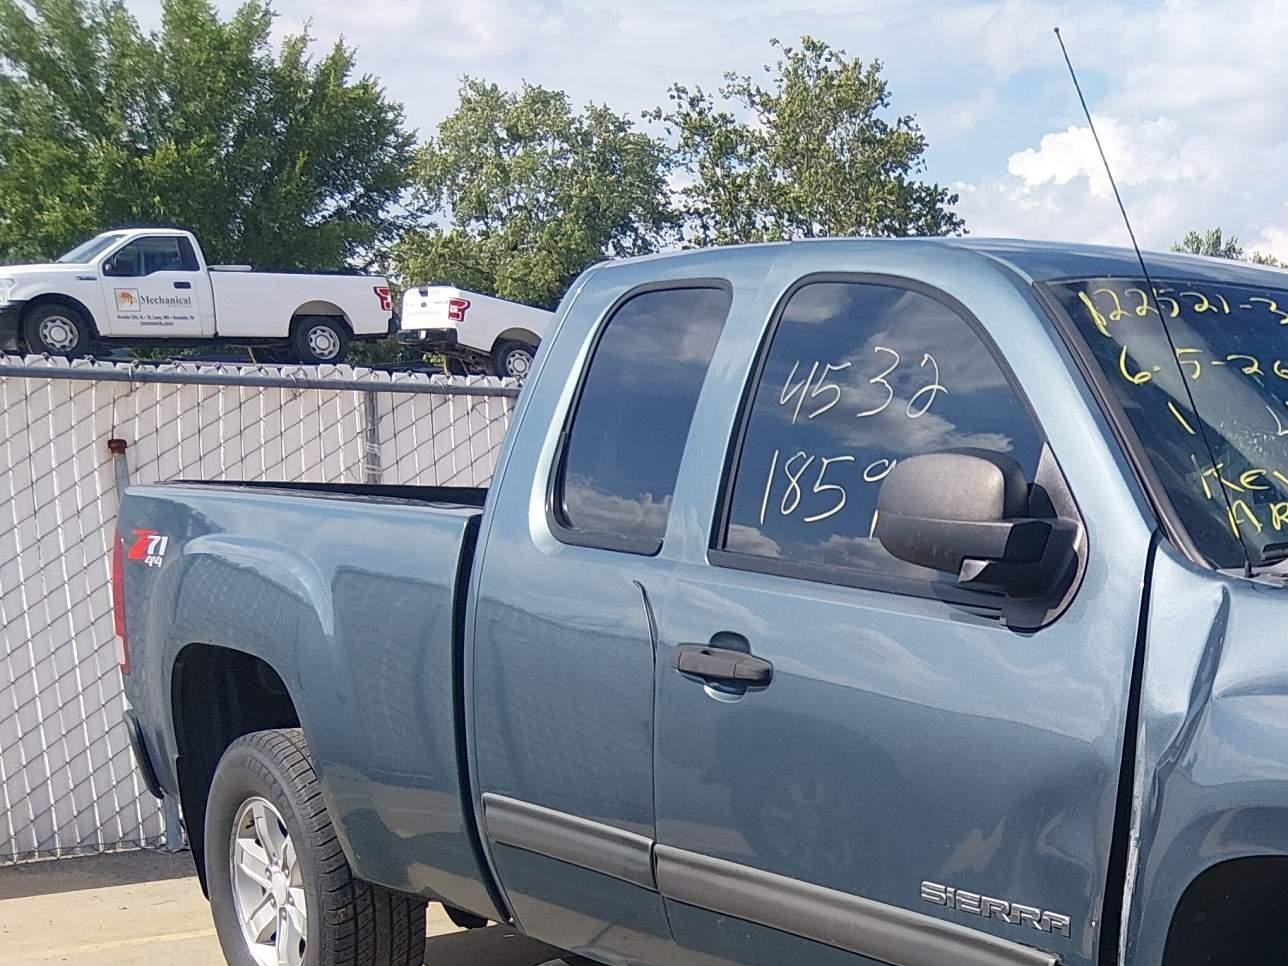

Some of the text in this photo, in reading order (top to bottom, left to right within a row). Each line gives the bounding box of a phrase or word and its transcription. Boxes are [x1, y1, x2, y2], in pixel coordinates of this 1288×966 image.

[140, 295, 192, 305] Mechanical
[779, 346, 949, 424] 4532
[920, 880, 1071, 938] SIERRA
